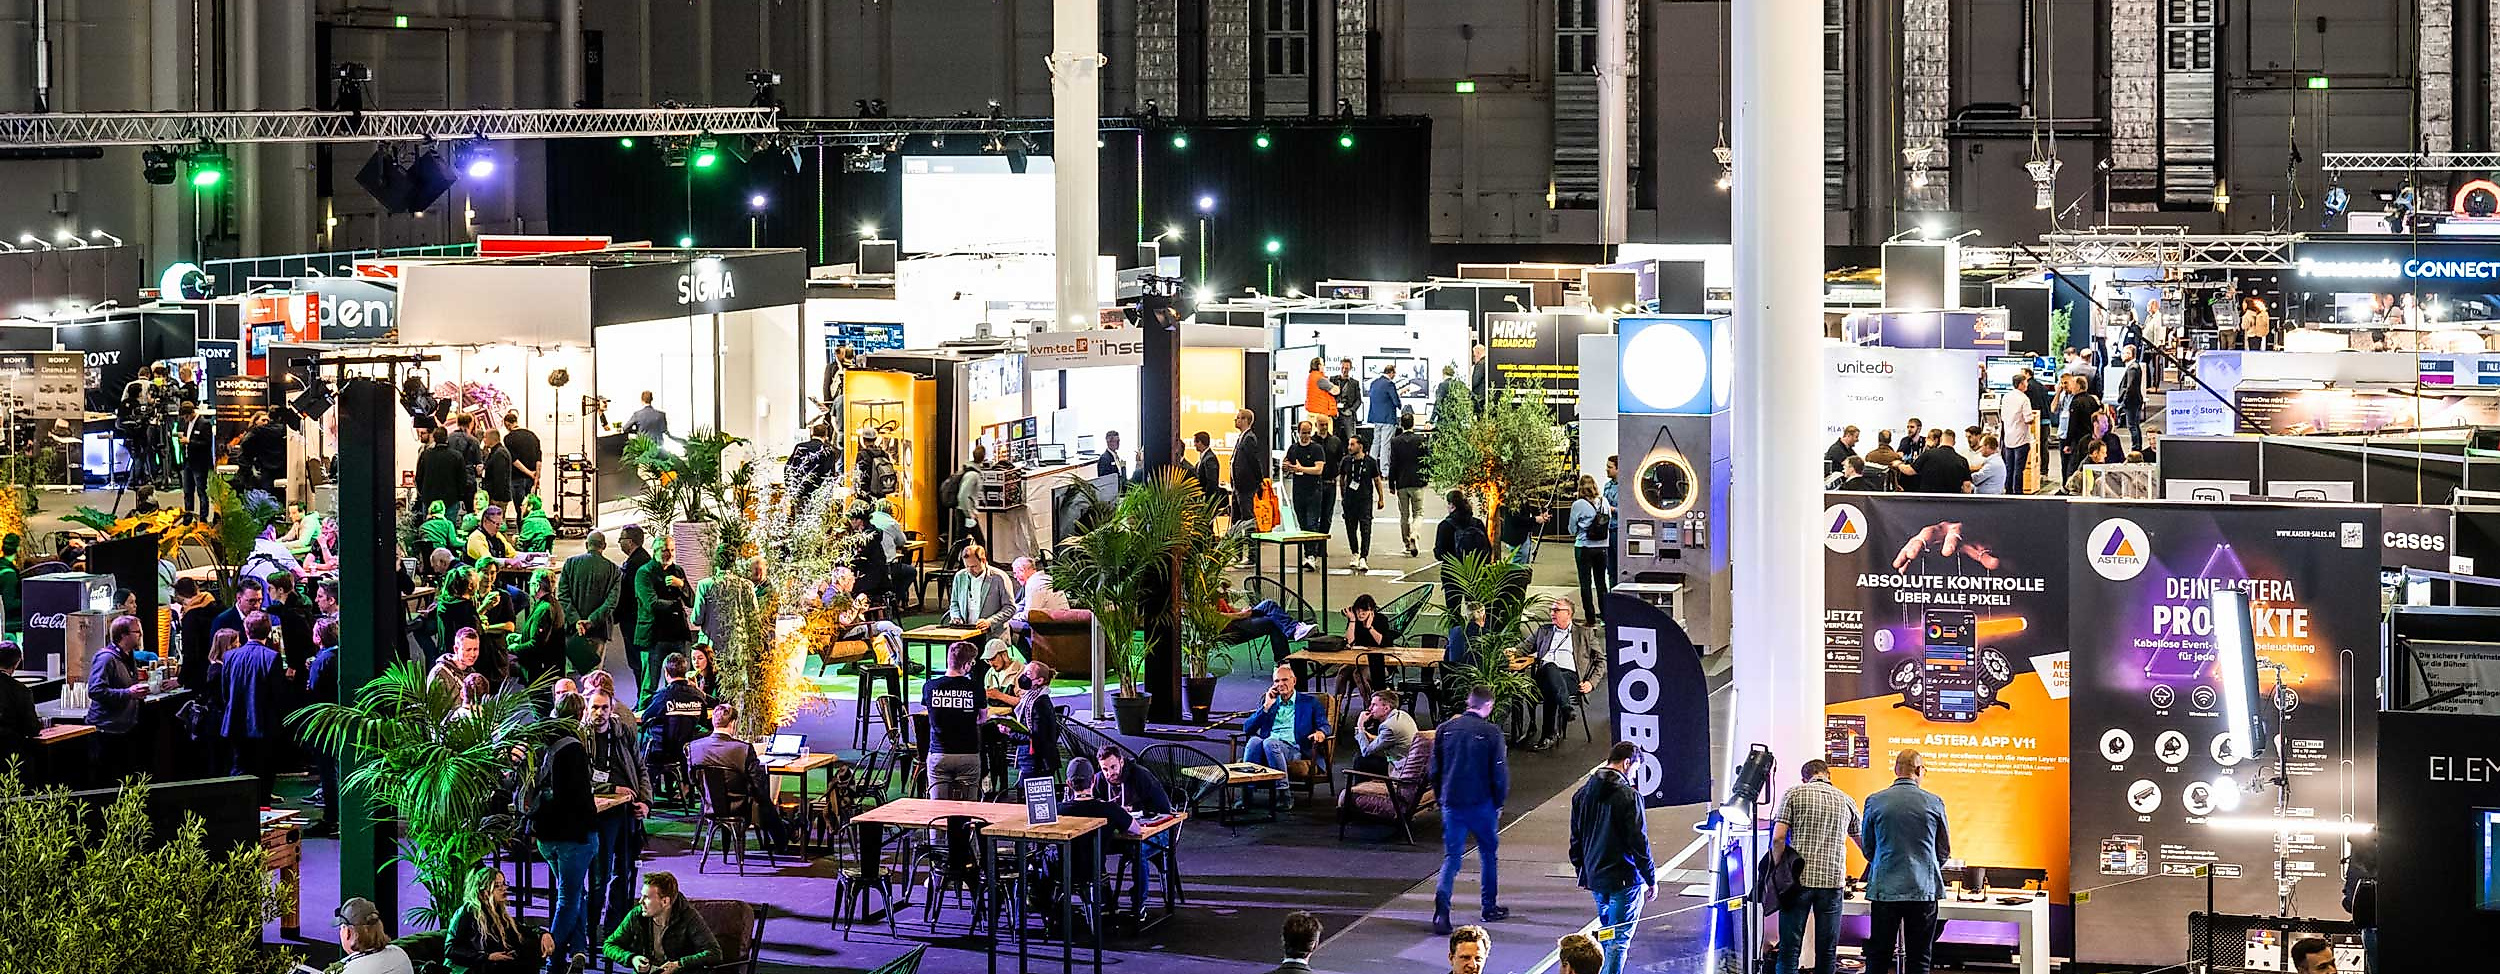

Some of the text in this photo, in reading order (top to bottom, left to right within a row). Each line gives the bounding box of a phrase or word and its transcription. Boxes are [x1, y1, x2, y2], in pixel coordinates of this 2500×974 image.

[2404, 258, 2500, 278] CONNECT
[677, 271, 736, 304] SIGMA
[1491, 320, 1537, 338] MRMC
[1491, 339, 1538, 347] BROADCAST
[198, 349, 232, 359] SONY
[2383, 531, 2445, 551] cases
[2097, 557, 2140, 565] ASTERA
[1856, 574, 2045, 592] ABSOLUTE KONTROLLE
[2166, 577, 2221, 600] DEINE
[1895, 590, 2011, 606] ÜBER ALLE PIXEL!
[1825, 609, 1863, 621] JETZT
[2153, 605, 2308, 638] PROKTE
[2178, 652, 2193, 661] für
[932, 690, 974, 698] HAMBURG
[675, 702, 702, 710] NewTek
[931, 697, 974, 709] OPEN
[1924, 733, 1978, 746] ASTERA
[1982, 736, 2010, 748] APP
[2013, 738, 2036, 749] V11
